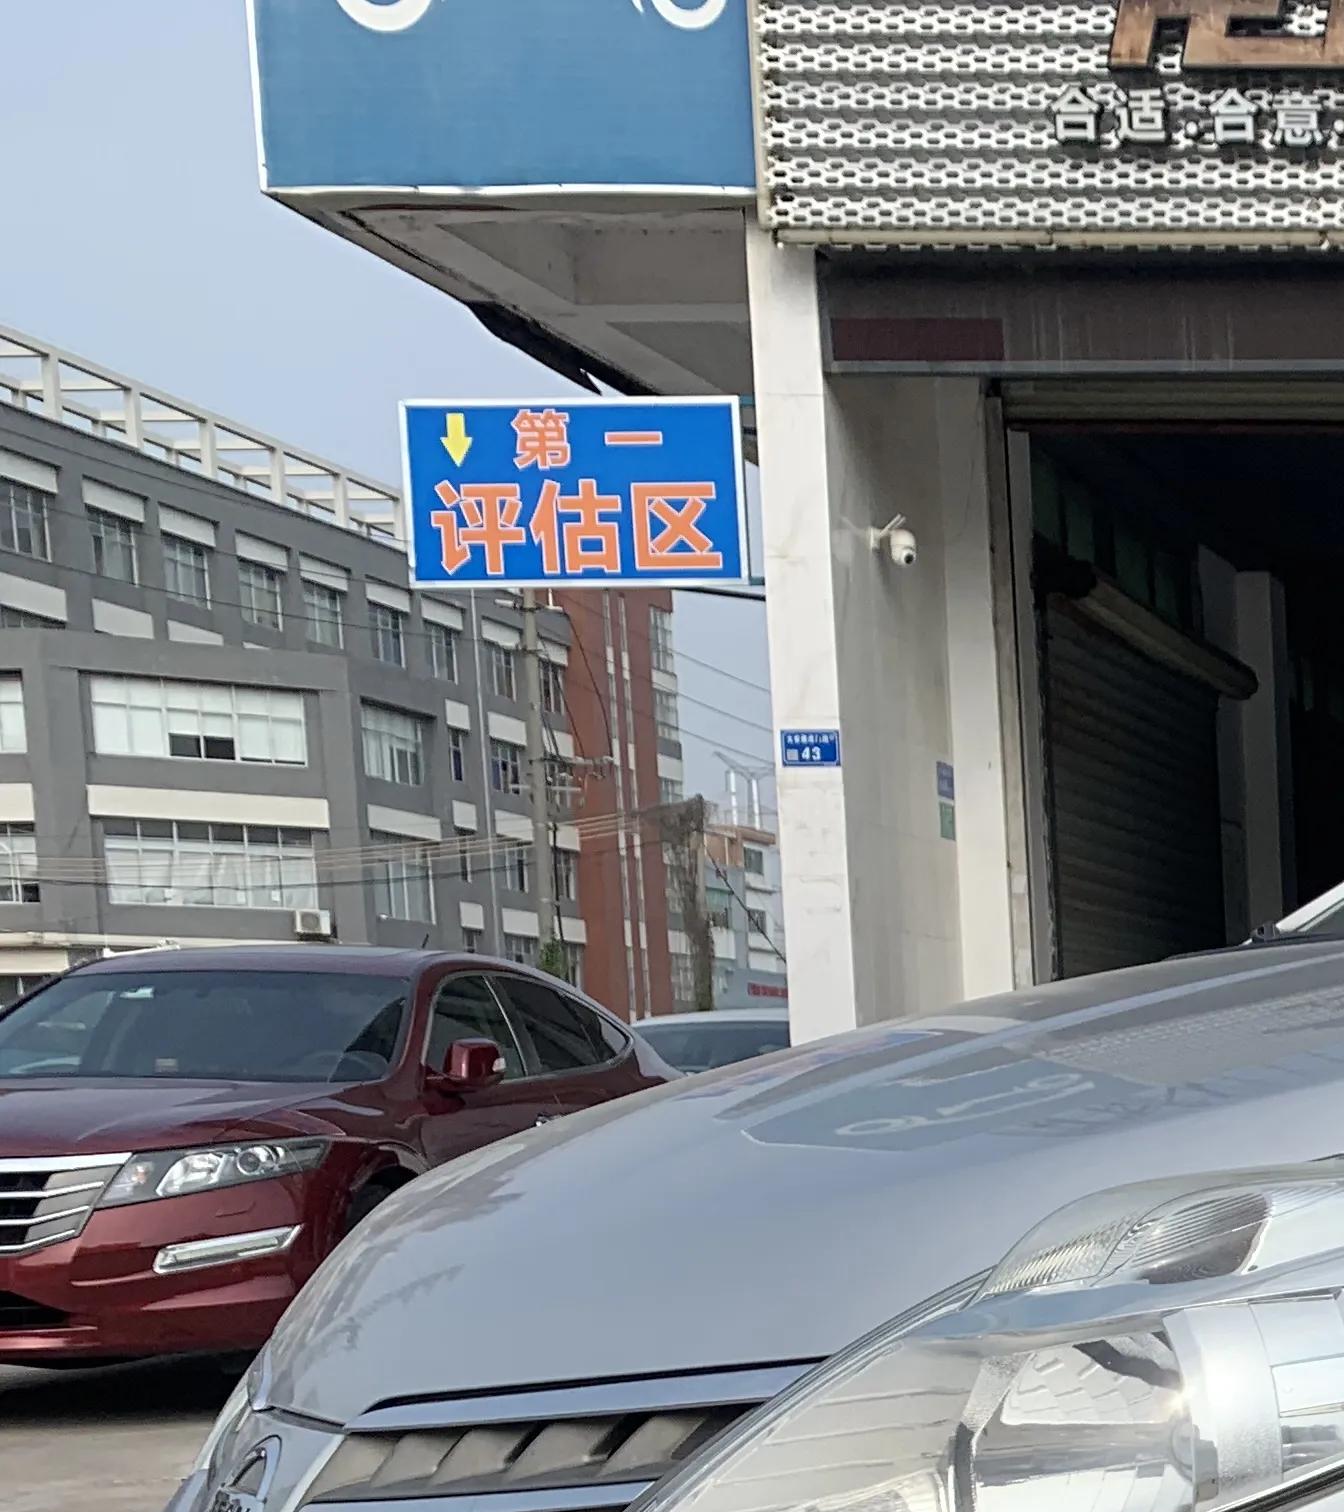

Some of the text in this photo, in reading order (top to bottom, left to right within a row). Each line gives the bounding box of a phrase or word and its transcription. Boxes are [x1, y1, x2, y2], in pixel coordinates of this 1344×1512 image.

[511, 409, 664, 471] 第一
[431, 479, 723, 576] 评估区
[801, 746, 821, 761] 43
